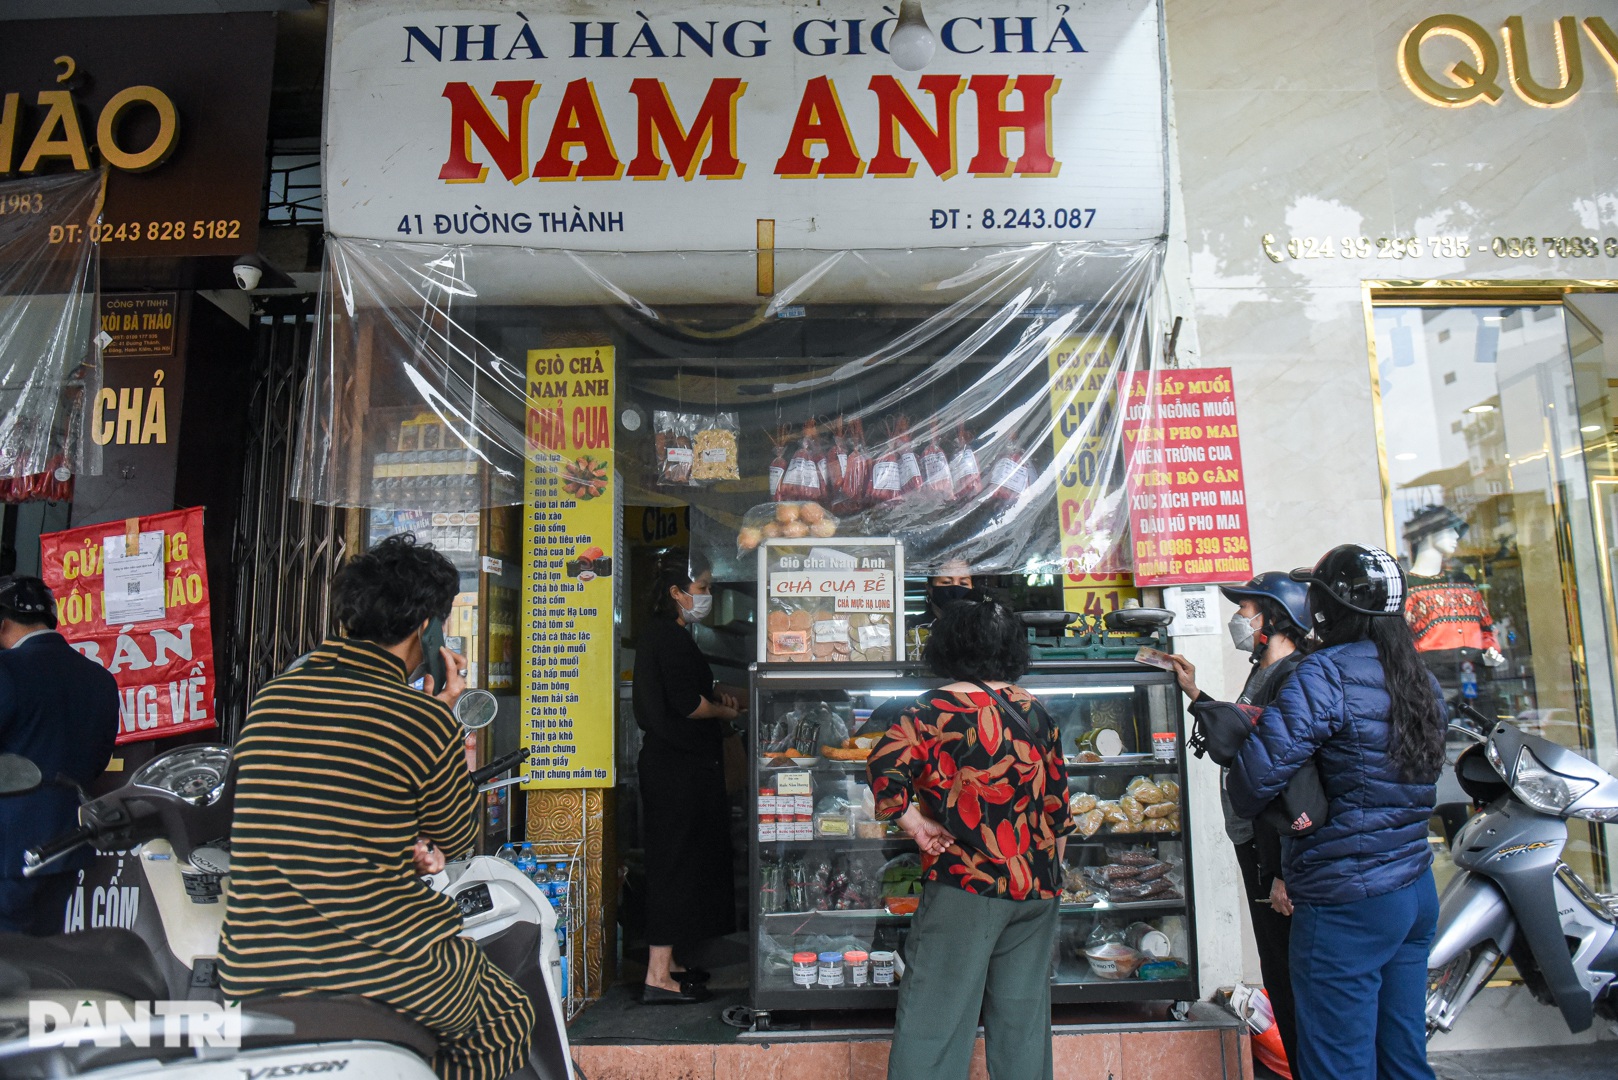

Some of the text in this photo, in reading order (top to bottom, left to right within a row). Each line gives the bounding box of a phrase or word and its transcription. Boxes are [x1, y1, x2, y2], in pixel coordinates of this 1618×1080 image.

[401, 11, 548, 63] NHÀ
[569, 10, 772, 59] HÀNG
[940, 4, 1089, 54] CHẢ
[438, 75, 1062, 186] NAM ANH
[397, 205, 624, 235] 41 ĐƯỜNG THÀNH
[982, 208, 1096, 229] 8.243.087
[48, 219, 241, 244] ĐT: 0243 828 5182
[1287, 236, 1600, 260] 024 39 286 735 086 7083
[101, 308, 172, 331] XÔI BÀ THẢO
[535, 350, 604, 375] GIÒ CHẢ
[529, 379, 609, 398] NAM ANH
[1188, 374, 1231, 395] MUỐI
[91, 369, 167, 446] CHẢ
[1157, 398, 1200, 419] NGỖNG
[1202, 396, 1236, 417] MUỐI
[527, 399, 610, 450] CHẢ CUA
[1168, 426, 1203, 440] PHO
[1205, 424, 1238, 439] MAI
[1165, 444, 1205, 463] TRỨNG
[1208, 445, 1233, 461] CUA
[1176, 467, 1199, 485] BÒ
[1202, 465, 1239, 484] GÂN
[1132, 489, 1244, 510] XÚC XÍCH PHO MAI
[534, 511, 546, 520] Giò
[1168, 513, 1187, 532] HŨ
[1188, 515, 1214, 532] PHO
[1216, 514, 1241, 530] MAI
[534, 523, 546, 532] Giò
[533, 535, 546, 544] Giò
[1159, 537, 1192, 557] 0986
[1195, 536, 1220, 555] 399
[1223, 536, 1249, 553] 534
[533, 547, 548, 556] Chả
[533, 559, 547, 568] Chả
[780, 556, 800, 568] Giò
[803, 556, 826, 568] chả
[861, 557, 886, 568] Anh
[1169, 556, 1183, 575] ÉP
[1185, 556, 1214, 575] CHÂN
[1215, 555, 1250, 573] KHÔNG
[532, 571, 547, 580] Chả
[532, 583, 547, 592] Chả
[776, 576, 813, 593] CHẢ
[819, 580, 856, 593] CUA
[532, 595, 547, 604] Chả
[837, 596, 850, 608] CHẢ
[532, 607, 547, 617] Chả
[567, 608, 577, 618] Hạ
[579, 607, 597, 616] Long
[532, 619, 547, 629] Chả
[532, 632, 547, 641] Chả
[531, 669, 542, 679] Gà
[169, 661, 207, 725] VỀ
[531, 694, 549, 703] Nem
[531, 707, 541, 716] Cá
[543, 707, 558, 716] kho
[531, 719, 546, 730] Thịt
[558, 718, 573, 728] khô
[531, 732, 546, 743] Thịt
[558, 731, 573, 741] khô
[531, 744, 576, 754] Bánh chưng
[531, 757, 551, 766] Bánh
[531, 769, 546, 781] Thịt
[547, 769, 571, 779] chưng
[91, 867, 139, 930] CỐM
[239, 1060, 349, 1080] VISION
